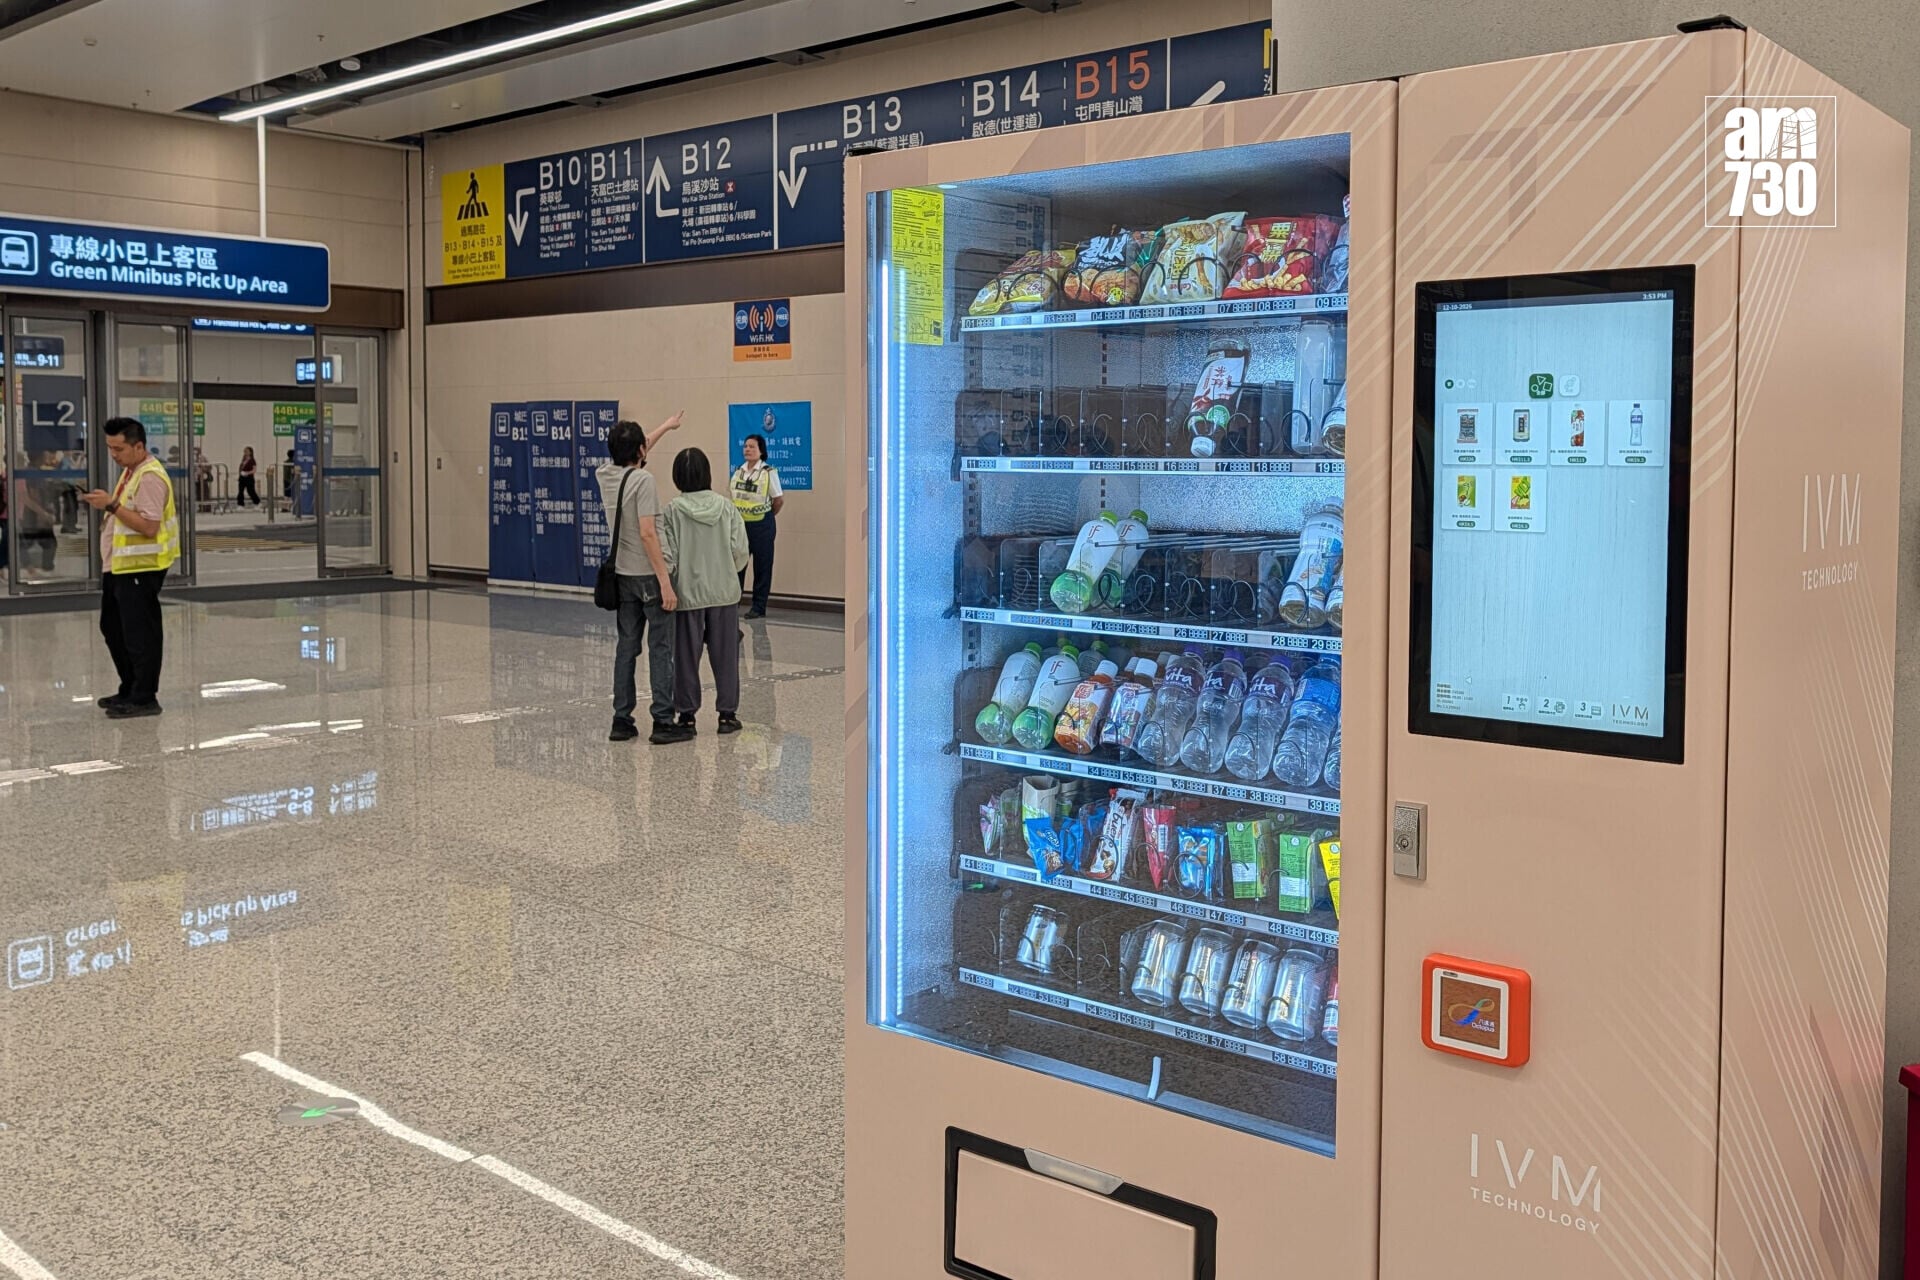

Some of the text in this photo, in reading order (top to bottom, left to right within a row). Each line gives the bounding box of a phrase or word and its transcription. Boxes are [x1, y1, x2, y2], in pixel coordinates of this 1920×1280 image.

[1075, 50, 1151, 100] B15
[972, 70, 1041, 118] B14
[1074, 95, 1144, 122] 屯門青山灣
[843, 96, 902, 139] B13
[591, 147, 631, 182] B11
[682, 137, 733, 176] B12
[540, 156, 581, 190] B10
[591, 180, 639, 197] 天富巴士總站
[682, 177, 720, 195] 烏溪沙站
[49, 233, 219, 271] 專線小巴上客區
[50, 261, 288, 294] Green Minibus Pick Up Area
[1169, 307, 1181, 316] 06
[1220, 304, 1231, 313] 07
[1259, 301, 1270, 311] 08
[1317, 298, 1329, 308] 09
[37, 354, 60, 367] 9-11
[32, 400, 76, 427] L2
[551, 426, 571, 440] B14
[1091, 461, 1101, 470] 14
[1126, 461, 1136, 470] 15
[1165, 462, 1176, 470] 16
[1217, 462, 1228, 471] 17
[1255, 462, 1267, 471] 18
[1318, 463, 1329, 472] 19
[1802, 473, 1861, 553] IVM
[1802, 560, 1859, 591] TECHNOLOGY
[1092, 621, 1102, 630] 24
[1175, 628, 1186, 637] 26
[1212, 631, 1223, 640] 27
[1273, 636, 1284, 645] 28
[1312, 640, 1323, 650] 29
[1543, 699, 1550, 708] 2
[1580, 702, 1586, 711] 3
[1612, 704, 1649, 720] IVM
[1089, 766, 1099, 775] 34
[1213, 785, 1224, 794] 37
[1249, 791, 1261, 801] 38
[1310, 799, 1322, 810] 39
[1172, 903, 1183, 913] 46
[1210, 911, 1221, 920] 47
[1269, 923, 1281, 933] 48
[1310, 931, 1322, 942] 49
[1471, 1022, 1496, 1033] Octopus
[1176, 1028, 1187, 1038] 56
[1211, 1036, 1222, 1046] 57
[1274, 1051, 1285, 1062] 58
[1312, 1062, 1324, 1073] 59
[1470, 1133, 1600, 1213] IVM
[1470, 1187, 1601, 1235] TECHNOLOGY
